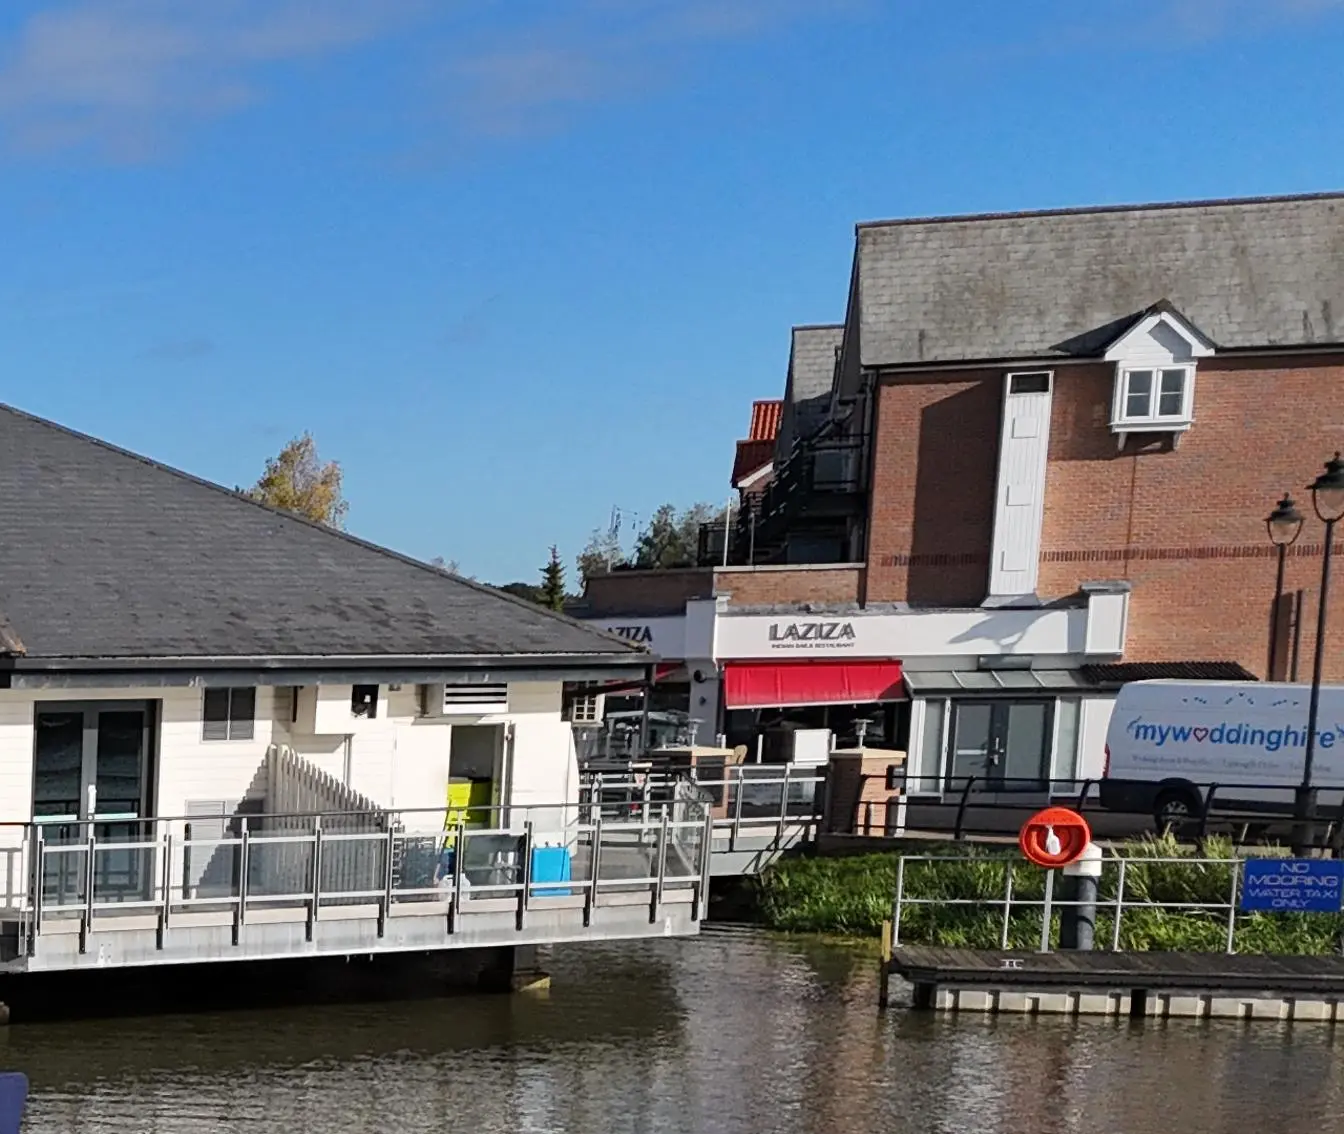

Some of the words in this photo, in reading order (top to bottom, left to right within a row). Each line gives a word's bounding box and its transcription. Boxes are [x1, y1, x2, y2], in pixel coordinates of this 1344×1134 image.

[608, 626, 653, 642] ZIZA
[768, 623, 856, 641] LAZIZA
[1280, 862, 1310, 873] NO
[1248, 874, 1338, 886] MOORING
[1249, 888, 1300, 897] WATER
[1304, 888, 1338, 898] TAXI
[1271, 899, 1311, 908] ONLY
